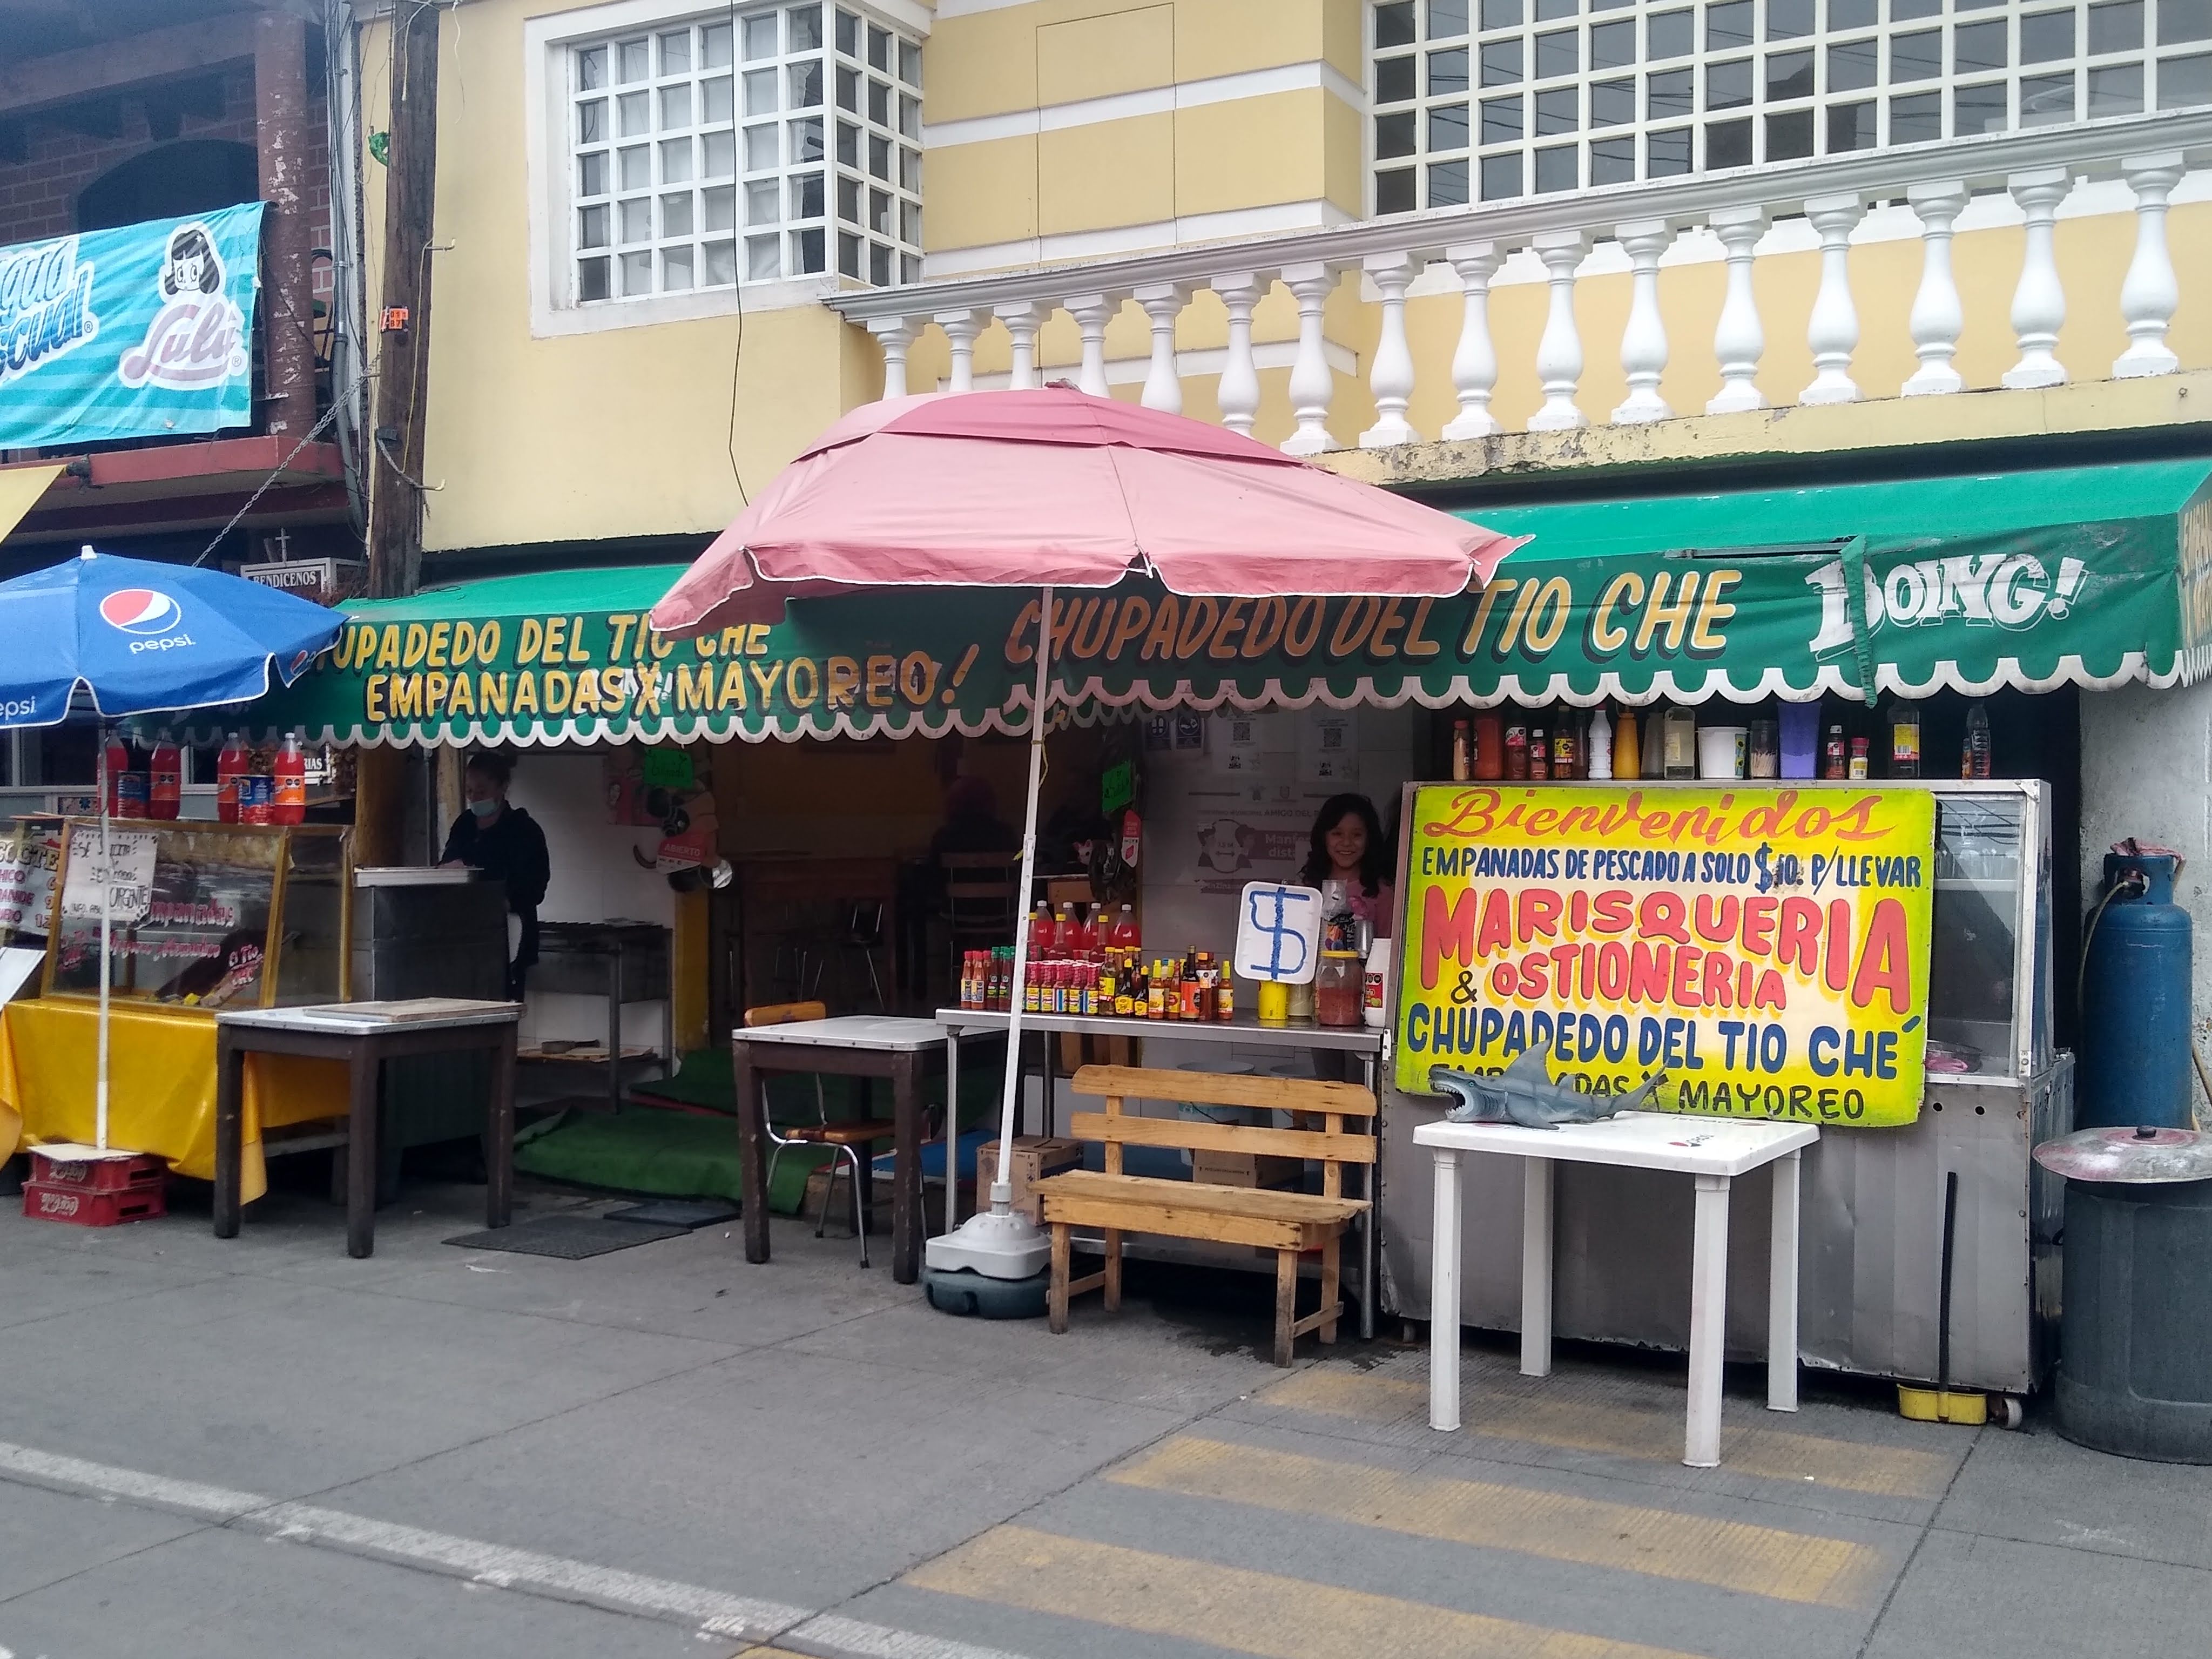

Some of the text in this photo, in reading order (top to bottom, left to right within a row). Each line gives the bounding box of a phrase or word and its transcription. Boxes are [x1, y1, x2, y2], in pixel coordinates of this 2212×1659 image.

[1005, 569, 1743, 664] CHUPADEDO DEL TIO CHE
[1804, 552, 2088, 658] BOING!
[130, 633, 195, 655] pepsi
[516, 616, 590, 666] DEL
[367, 666, 624, 722] EMPANADAS
[635, 661, 660, 716] X
[1423, 787, 1898, 846] Bienvenidos
[664, 843, 701, 857] ABIERTO
[1422, 846, 1560, 879] EMPANADAS
[1566, 849, 1589, 880] DE
[1593, 849, 1680, 882] PESCADO
[1682, 851, 1697, 883] A
[1701, 851, 1750, 884] SOLO
[1422, 885, 1911, 1015] MARISQUERIA
[1450, 941, 1786, 1010] & OSTIONERIA
[1407, 1002, 1628, 1063] CHUPADEDO
[1638, 1016, 1703, 1070] DEL
[1717, 1021, 1789, 1074] TIO
[1678, 1082, 1865, 1118] MAYOREO
